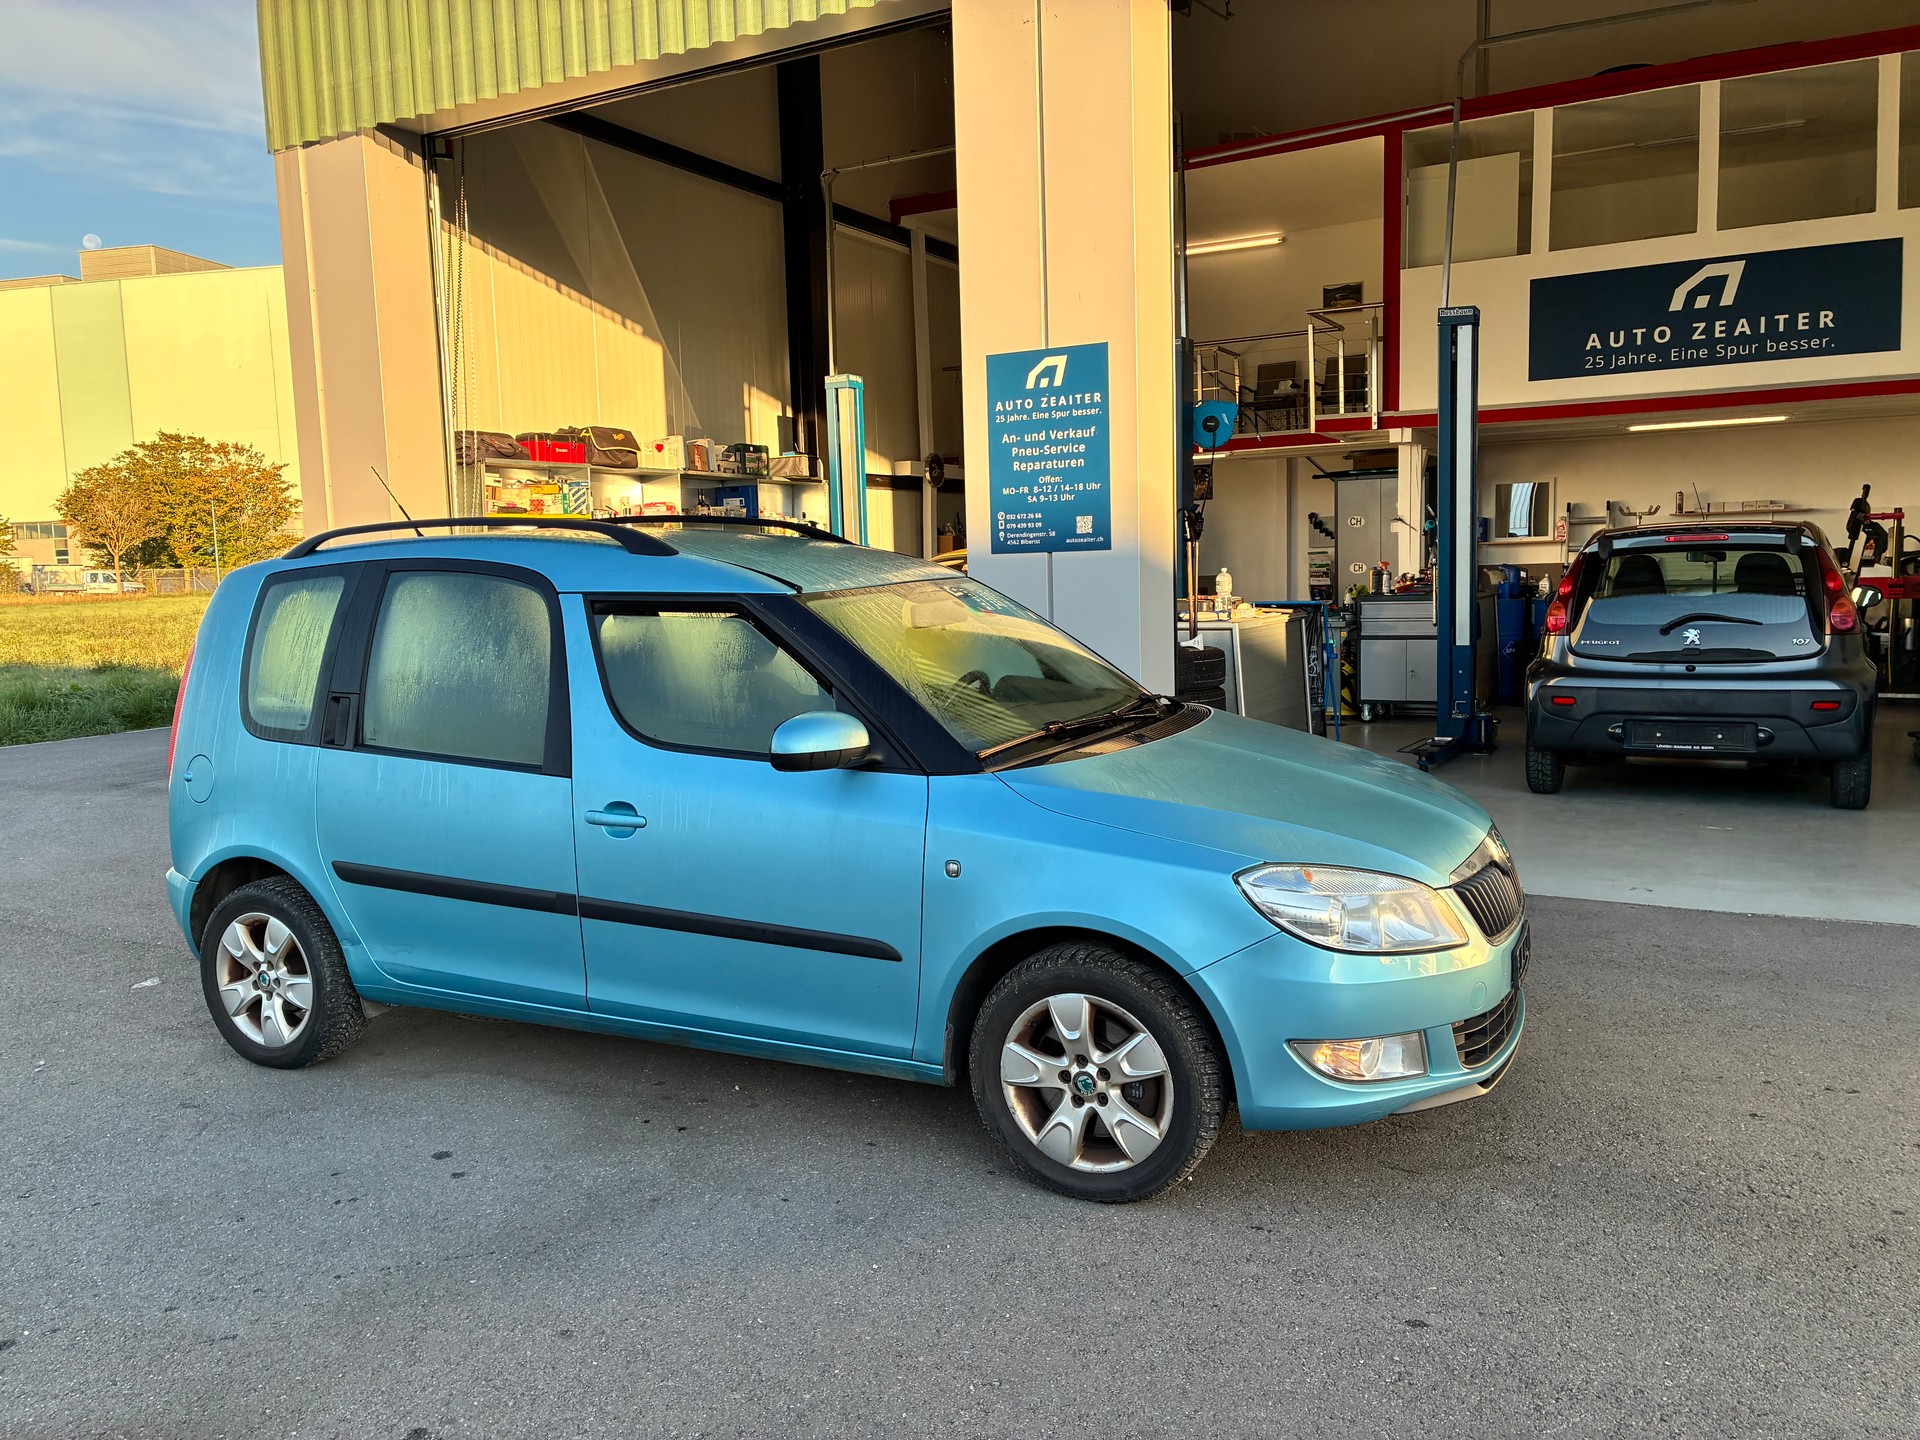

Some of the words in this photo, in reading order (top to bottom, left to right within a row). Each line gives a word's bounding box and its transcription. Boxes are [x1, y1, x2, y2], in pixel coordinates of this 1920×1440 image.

[1585, 326, 1671, 351] AUTO
[1691, 310, 1836, 341] ZEAITER
[1585, 355, 1604, 369] 25
[1610, 351, 1663, 370] Jahre.
[1671, 347, 1708, 362] Eine
[1716, 341, 1758, 360] Spur
[1766, 335, 1835, 353] besser.
[995, 399, 1033, 412] AUTO
[1040, 392, 1102, 408] ZEAITER
[995, 415, 1005, 423] 25
[1006, 413, 1030, 423] Jahre.
[1032, 411, 1049, 420] Eine
[1051, 410, 1070, 419] Spur
[1072, 407, 1102, 416] besser.
[1001, 433, 1021, 443] An-
[1024, 429, 1046, 442] und
[1049, 426, 1096, 440] Verkauf
[1011, 442, 1086, 457] Pneu-Service
[1013, 458, 1085, 473] Reparaturen
[1038, 476, 1063, 484] Offen:
[1002, 486, 1029, 495] MO-FR
[1033, 485, 1052, 493] 8-12
[1060, 483, 1084, 491] 14-18
[1086, 482, 1101, 490] Uhr
[1027, 495, 1037, 503] SA
[1039, 494, 1058, 502] 9-13
[1060, 493, 1075, 501] Uhr
[1349, 517, 1362, 526] CH
[1353, 563, 1364, 572] CH
